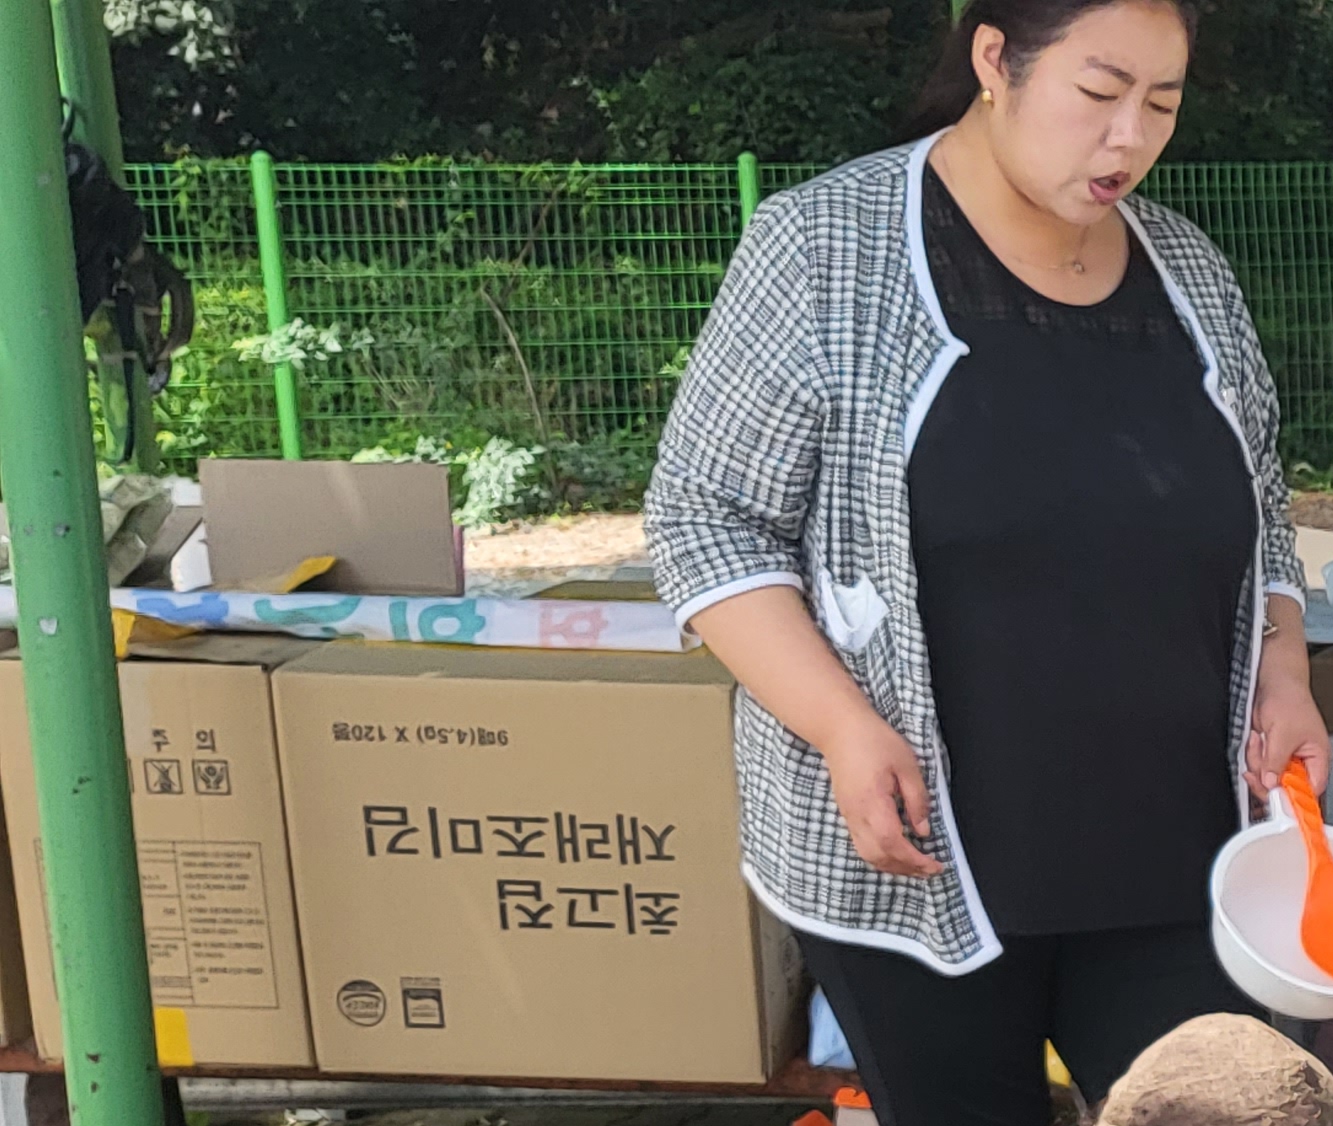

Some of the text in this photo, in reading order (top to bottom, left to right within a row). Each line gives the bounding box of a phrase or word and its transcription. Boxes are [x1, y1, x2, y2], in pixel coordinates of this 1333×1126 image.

[151, 728, 216, 754] 주 의
[361, 804, 677, 866] 재래조미김
[495, 878, 681, 936] 최고집
